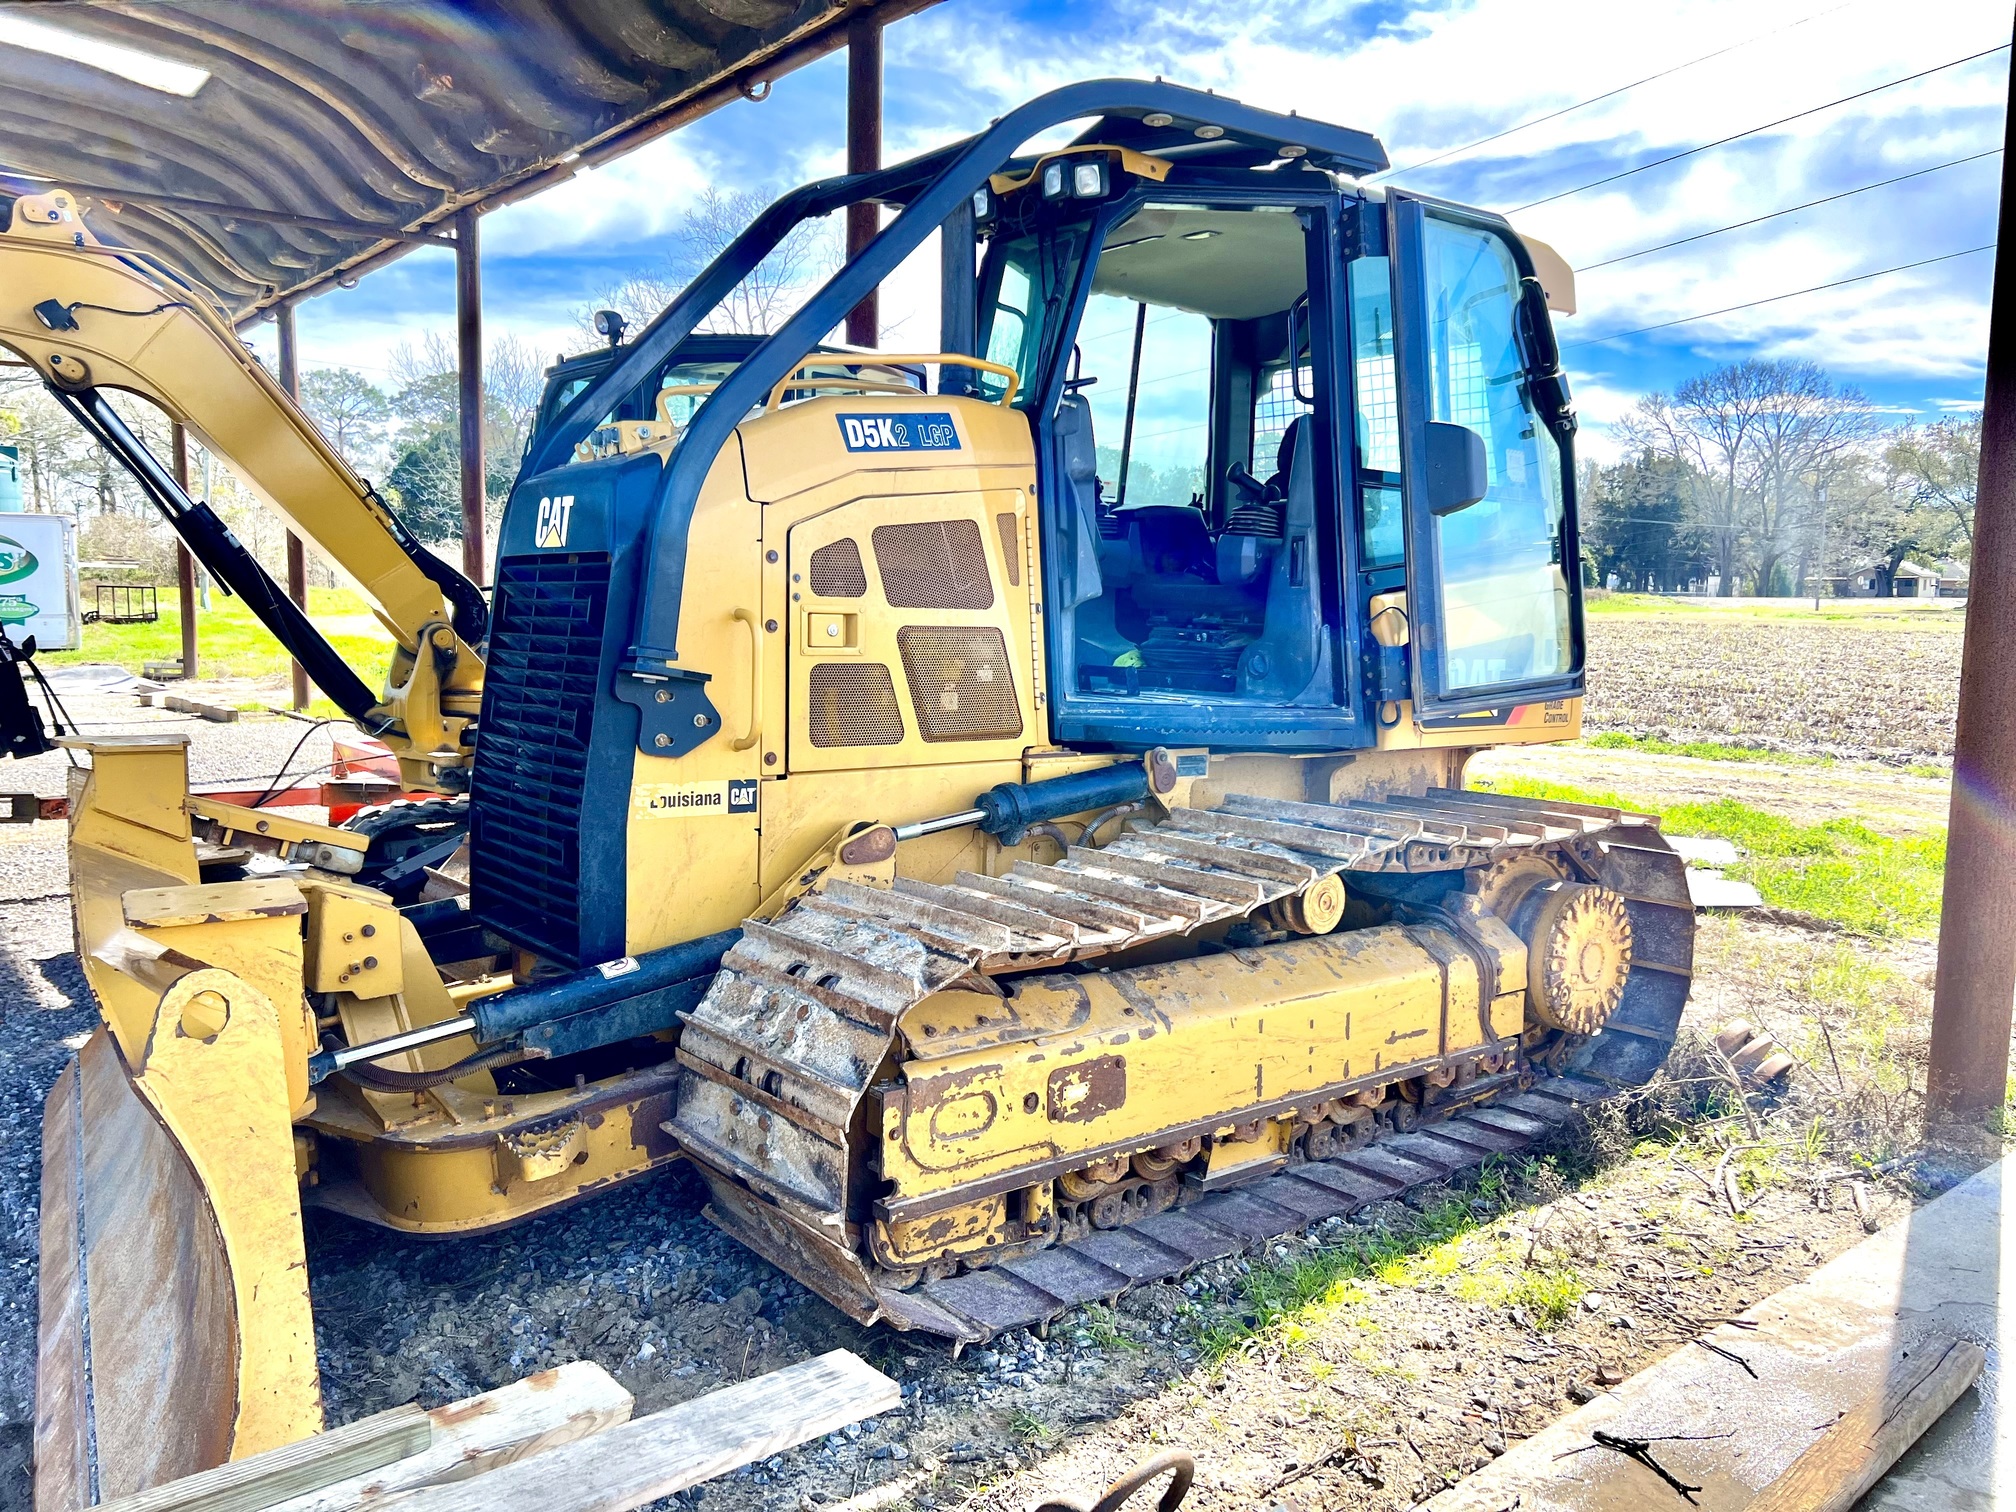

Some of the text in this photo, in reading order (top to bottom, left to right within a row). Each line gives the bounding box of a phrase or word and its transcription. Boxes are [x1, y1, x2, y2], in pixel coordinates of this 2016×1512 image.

[917, 424, 954, 446] LGP
[535, 495, 575, 548] CAT
[1543, 712, 1568, 723] CONTROL
[730, 787, 757, 806] CAT
